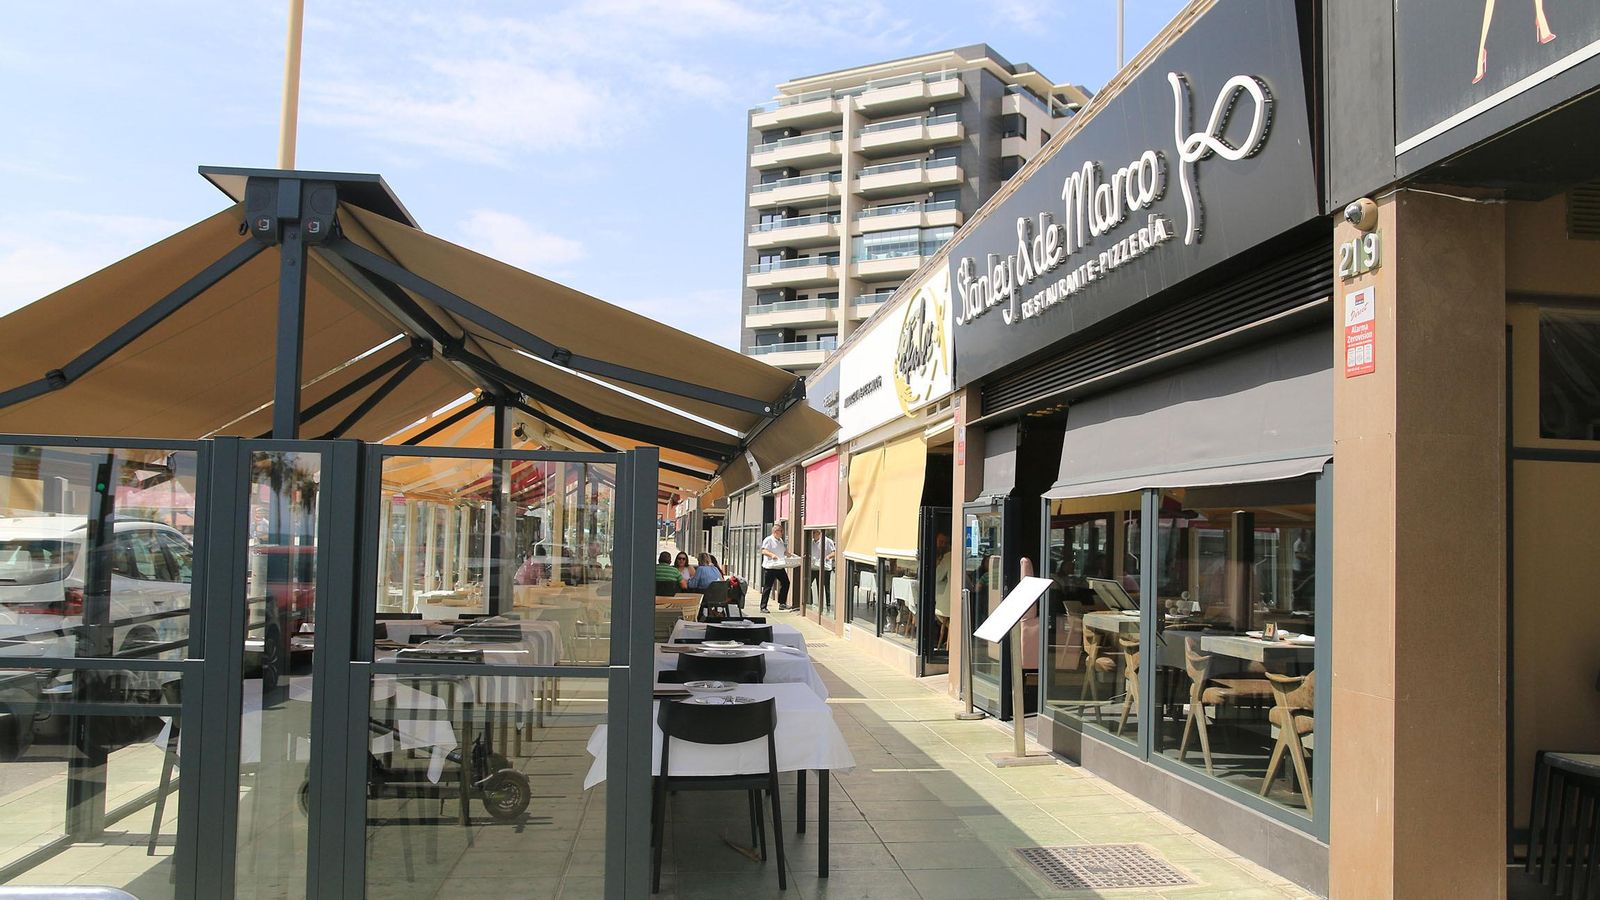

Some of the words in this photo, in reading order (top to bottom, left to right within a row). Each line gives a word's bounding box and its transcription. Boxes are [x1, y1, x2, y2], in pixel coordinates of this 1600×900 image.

[956, 252, 1018, 326] Stanley
[1061, 150, 1163, 256] Marco
[1339, 232, 1380, 279] 219
